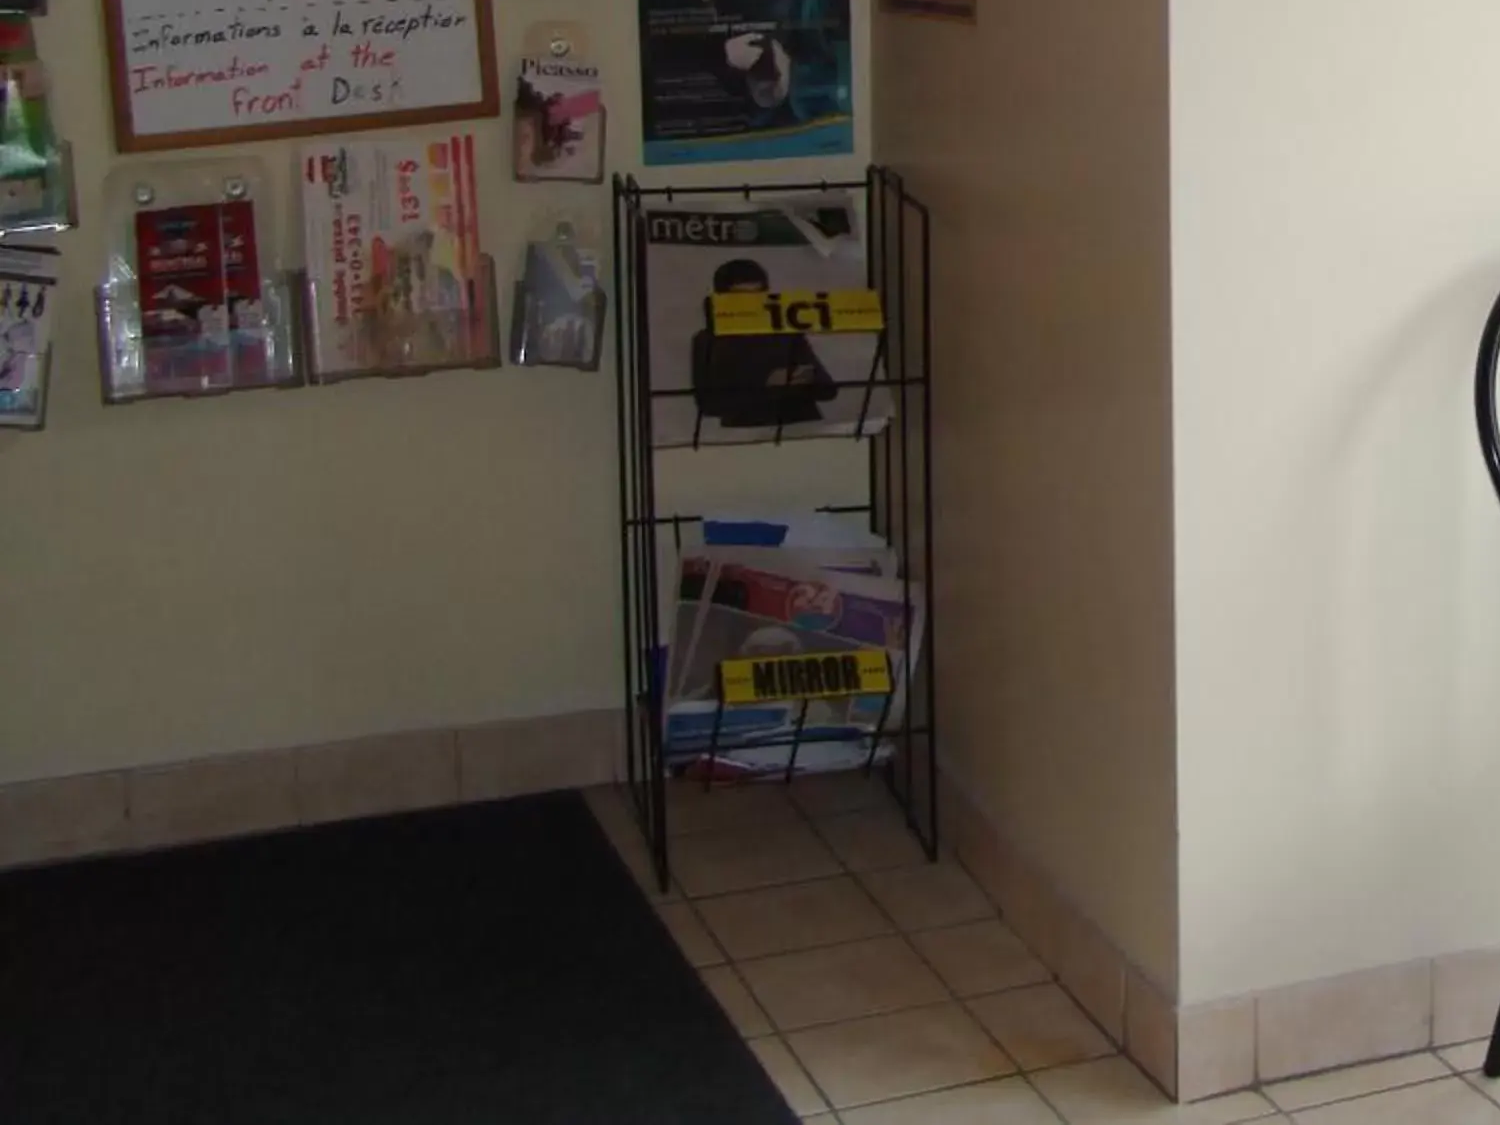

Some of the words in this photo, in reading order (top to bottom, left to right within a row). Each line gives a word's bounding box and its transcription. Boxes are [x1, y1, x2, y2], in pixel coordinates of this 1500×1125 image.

[131, 21, 282, 53] Informations
[332, 11, 356, 37] la
[361, 3, 467, 41] réception
[131, 55, 271, 95] Information
[299, 43, 331, 72] at
[350, 44, 397, 71] the
[521, 58, 600, 78] Picasso
[763, 292, 832, 331] ici
[752, 655, 861, 697] MIRROR
